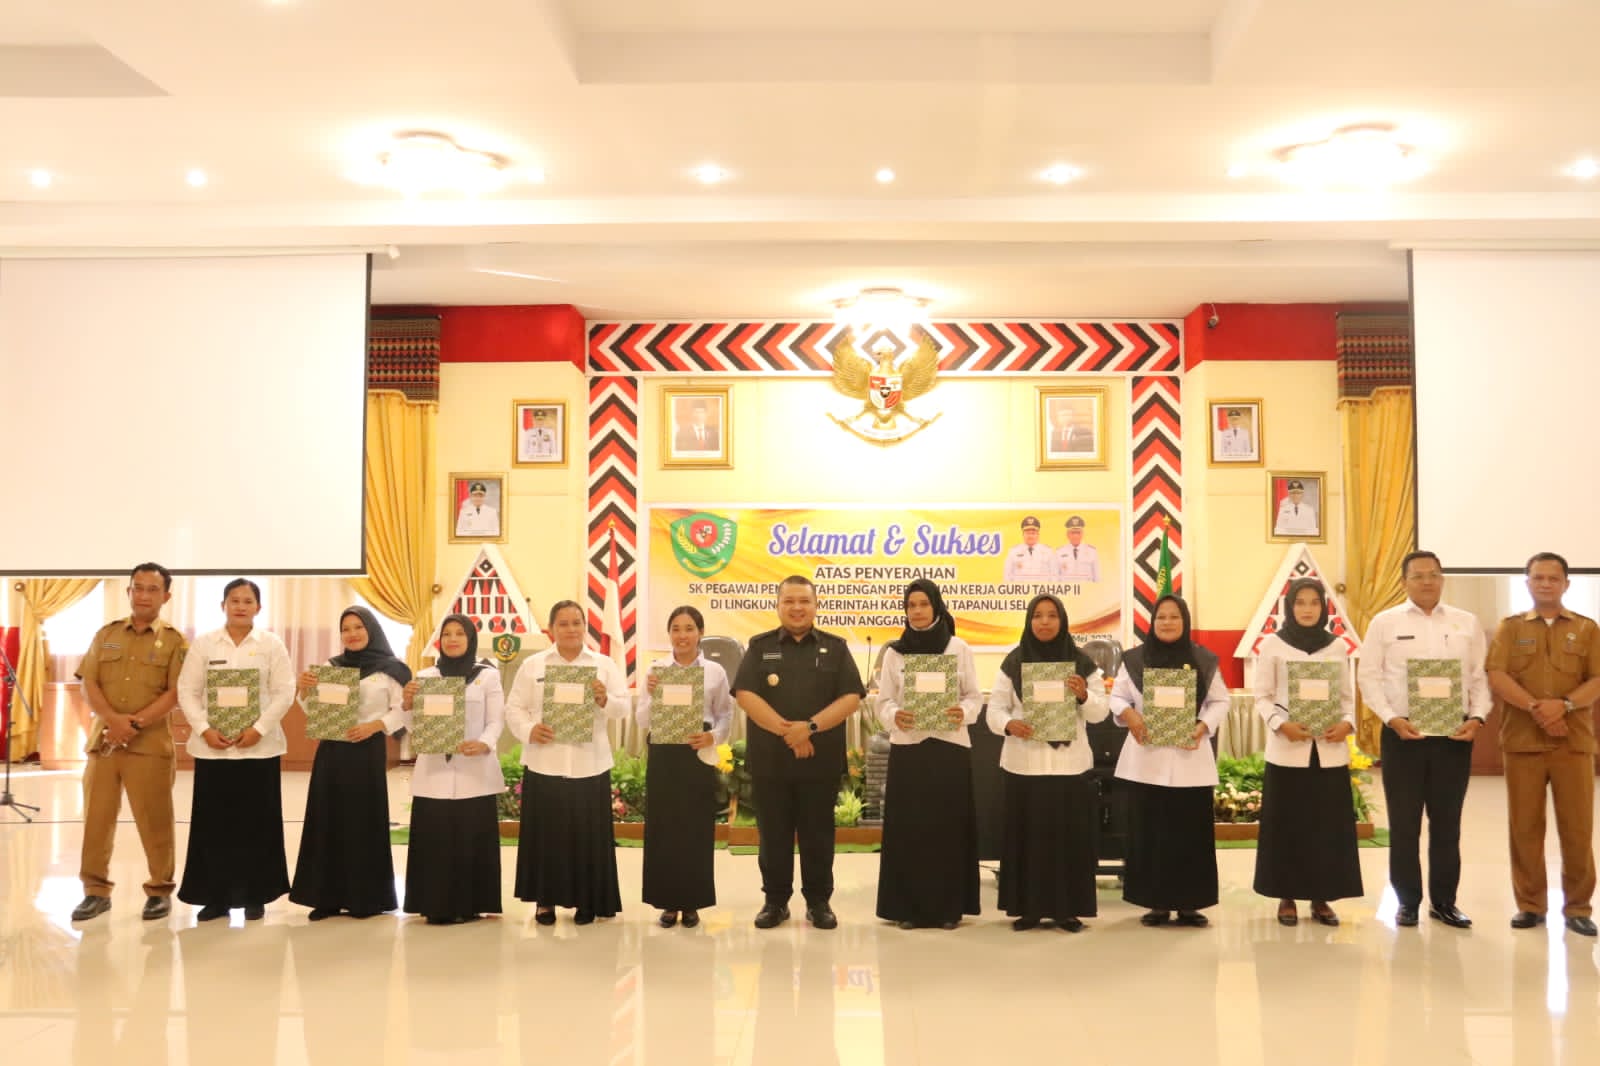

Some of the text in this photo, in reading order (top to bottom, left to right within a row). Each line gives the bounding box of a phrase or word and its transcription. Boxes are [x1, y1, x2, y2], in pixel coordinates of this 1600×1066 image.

[768, 524, 1001, 556] Selamat & Sukses
[815, 567, 956, 580] ATAS PENYERAHAN
[688, 583, 703, 594] SK
[705, 583, 759, 594] PEGAWAI
[837, 584, 887, 595] DENGAN
[960, 584, 996, 595] KERJA
[998, 584, 1030, 595] GURU
[1032, 584, 1071, 596] TAHAP
[1073, 584, 1081, 596] II
[710, 599, 722, 610] DI
[725, 599, 777, 610] LINGKUN
[817, 599, 879, 610] MERINTAH
[952, 599, 1008, 611] TAPANULI
[815, 615, 907, 626] TAHUN ANGGAR
